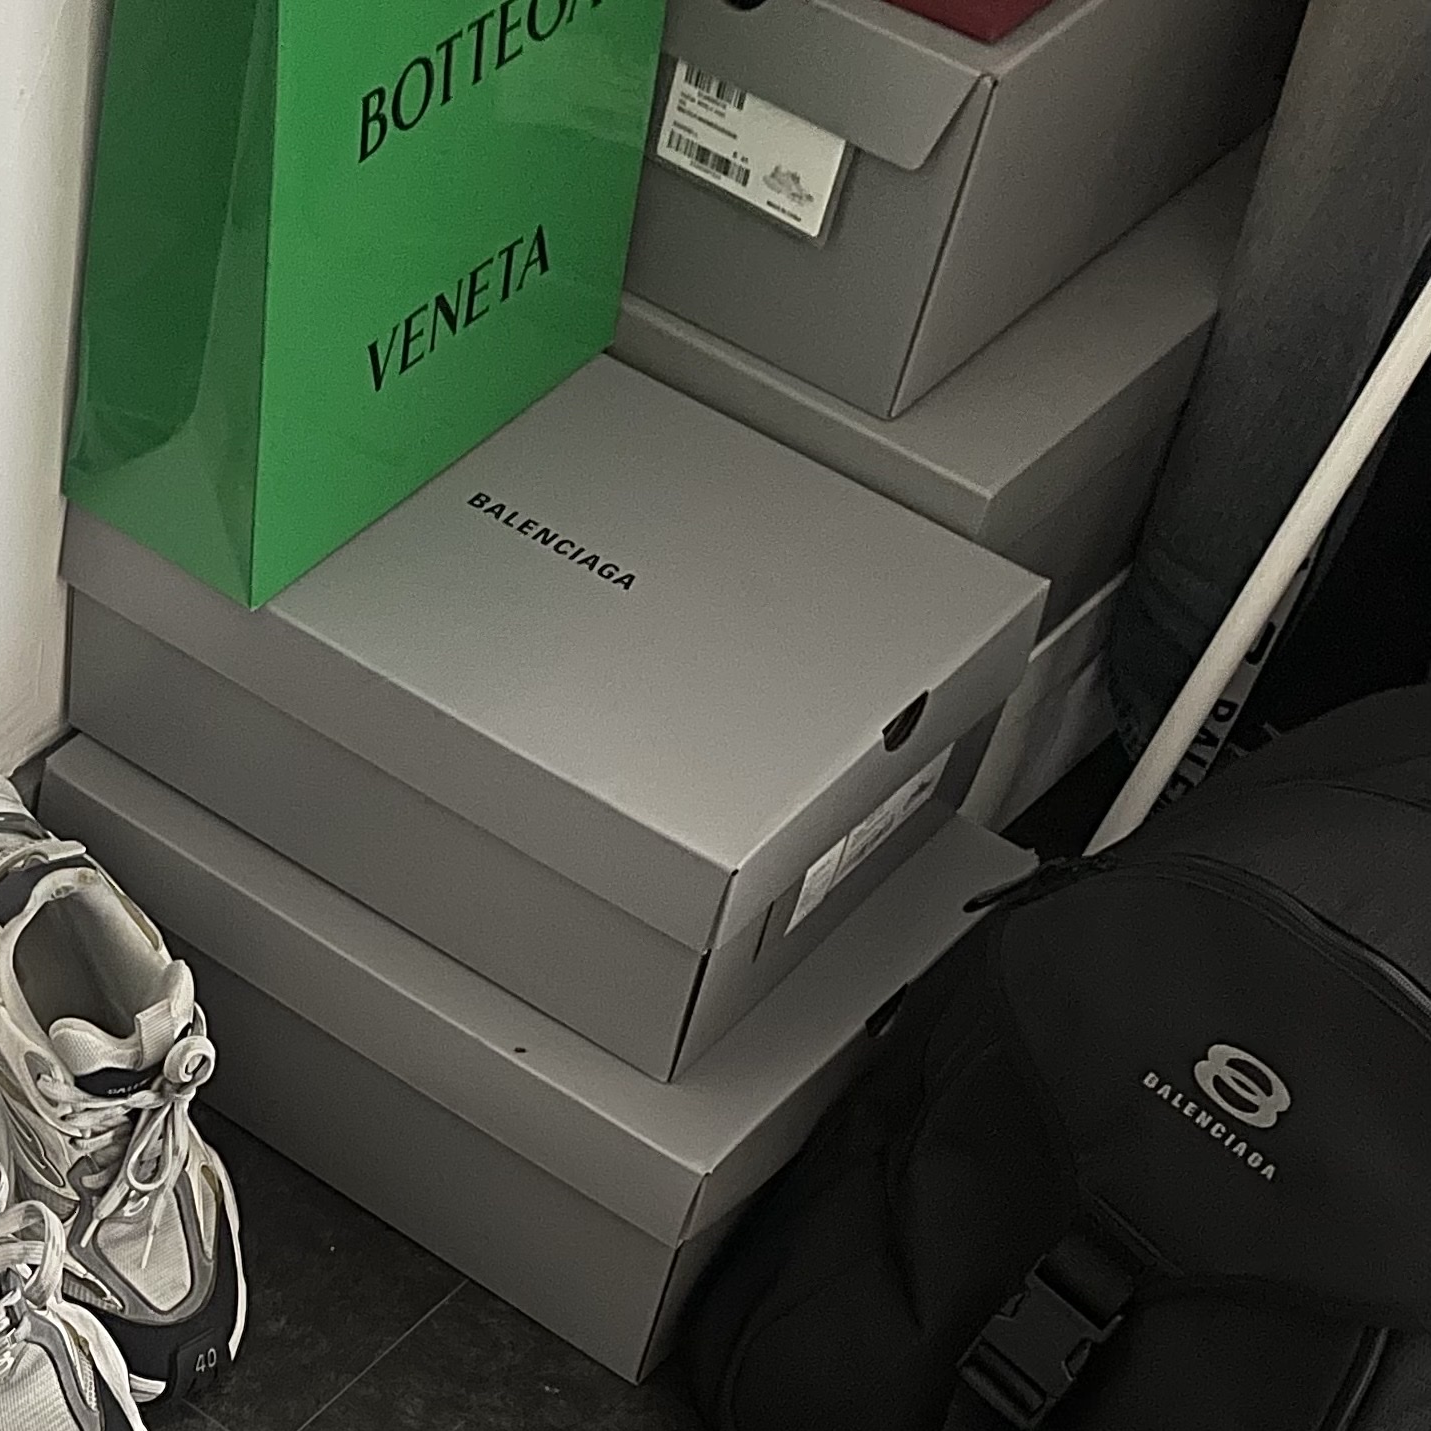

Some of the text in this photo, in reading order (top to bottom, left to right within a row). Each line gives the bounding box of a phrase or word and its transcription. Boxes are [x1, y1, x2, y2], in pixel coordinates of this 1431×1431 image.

[368, 224, 549, 392] VENETA
[467, 492, 636, 590] BALENCIAGA
[1143, 1072, 1276, 1180] BALENCIAGA
[194, 1347, 217, 1372] 40
